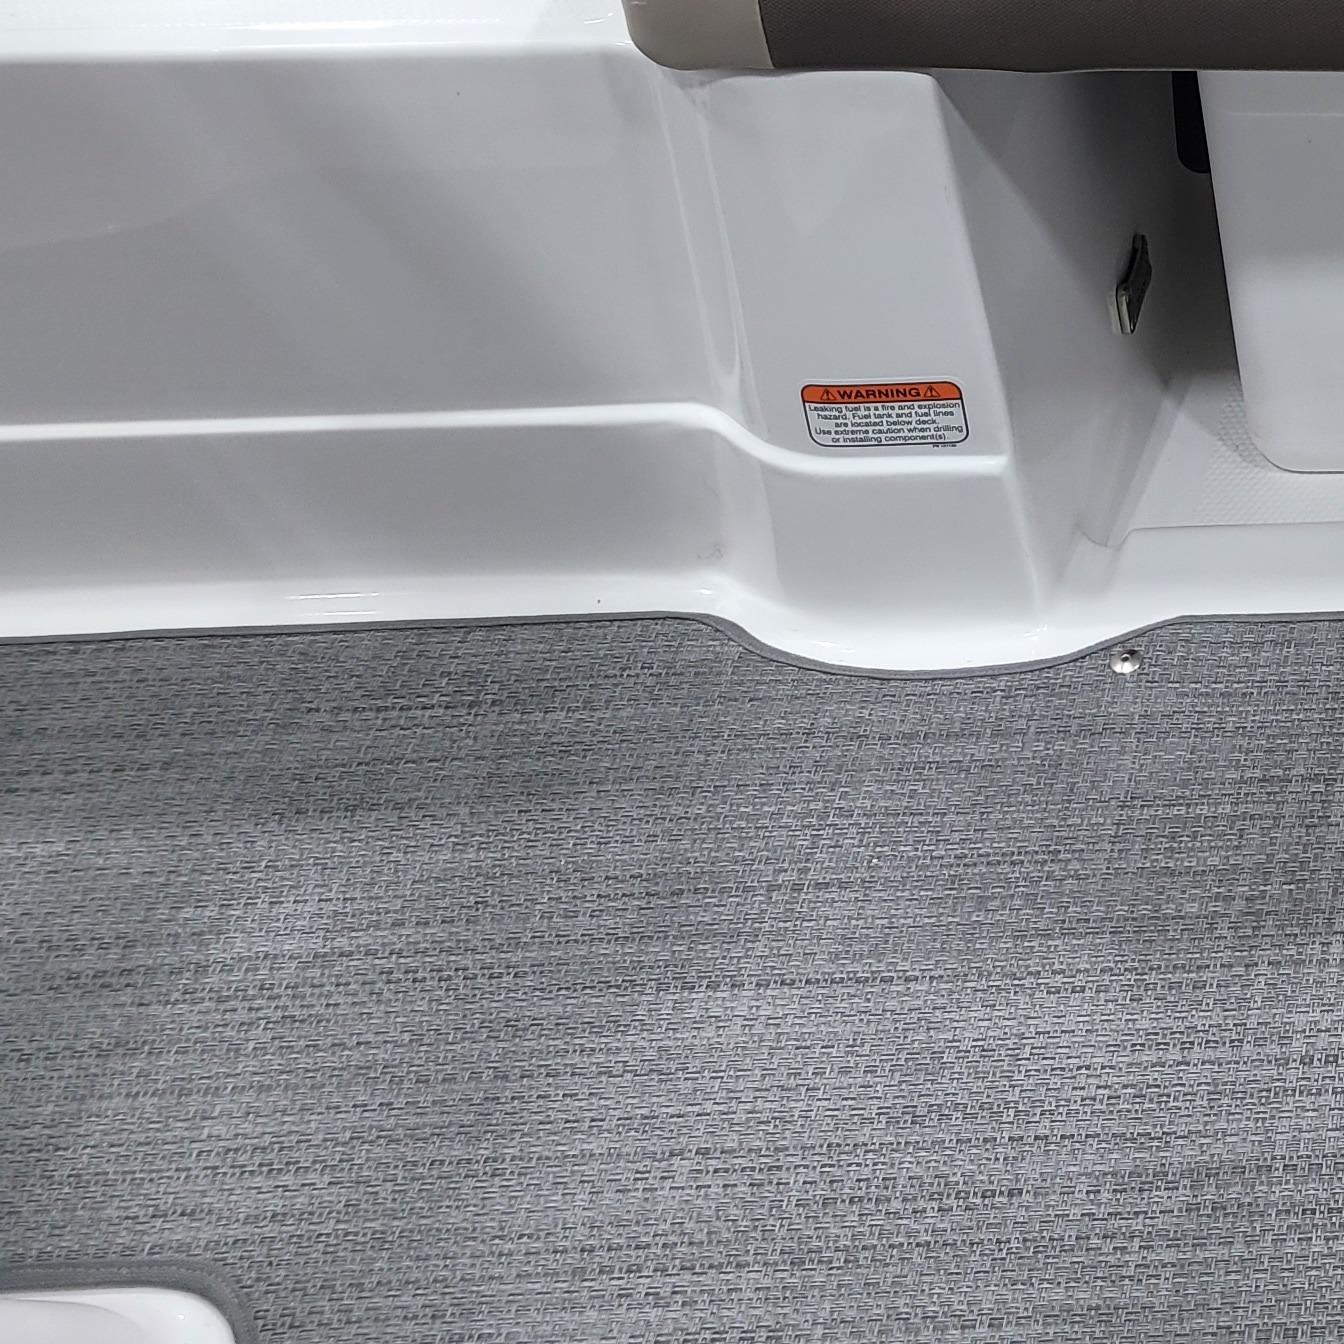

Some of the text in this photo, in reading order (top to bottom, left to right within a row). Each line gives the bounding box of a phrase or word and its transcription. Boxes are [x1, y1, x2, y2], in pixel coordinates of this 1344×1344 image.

[836, 387, 922, 400] WARNING
[808, 404, 843, 414] Leaking
[897, 403, 915, 411] and
[917, 402, 961, 412] explosion
[852, 412, 872, 420] Fuel
[895, 411, 912, 419] and
[914, 410, 931, 418] fuel
[933, 409, 954, 417] lines
[850, 420, 884, 428] located
[886, 419, 913, 427] below
[814, 427, 832, 435] Use
[833, 427, 870, 435] extreme
[871, 426, 905, 435] caution
[933, 424, 964, 433] drilling
[843, 435, 882, 444] installing
